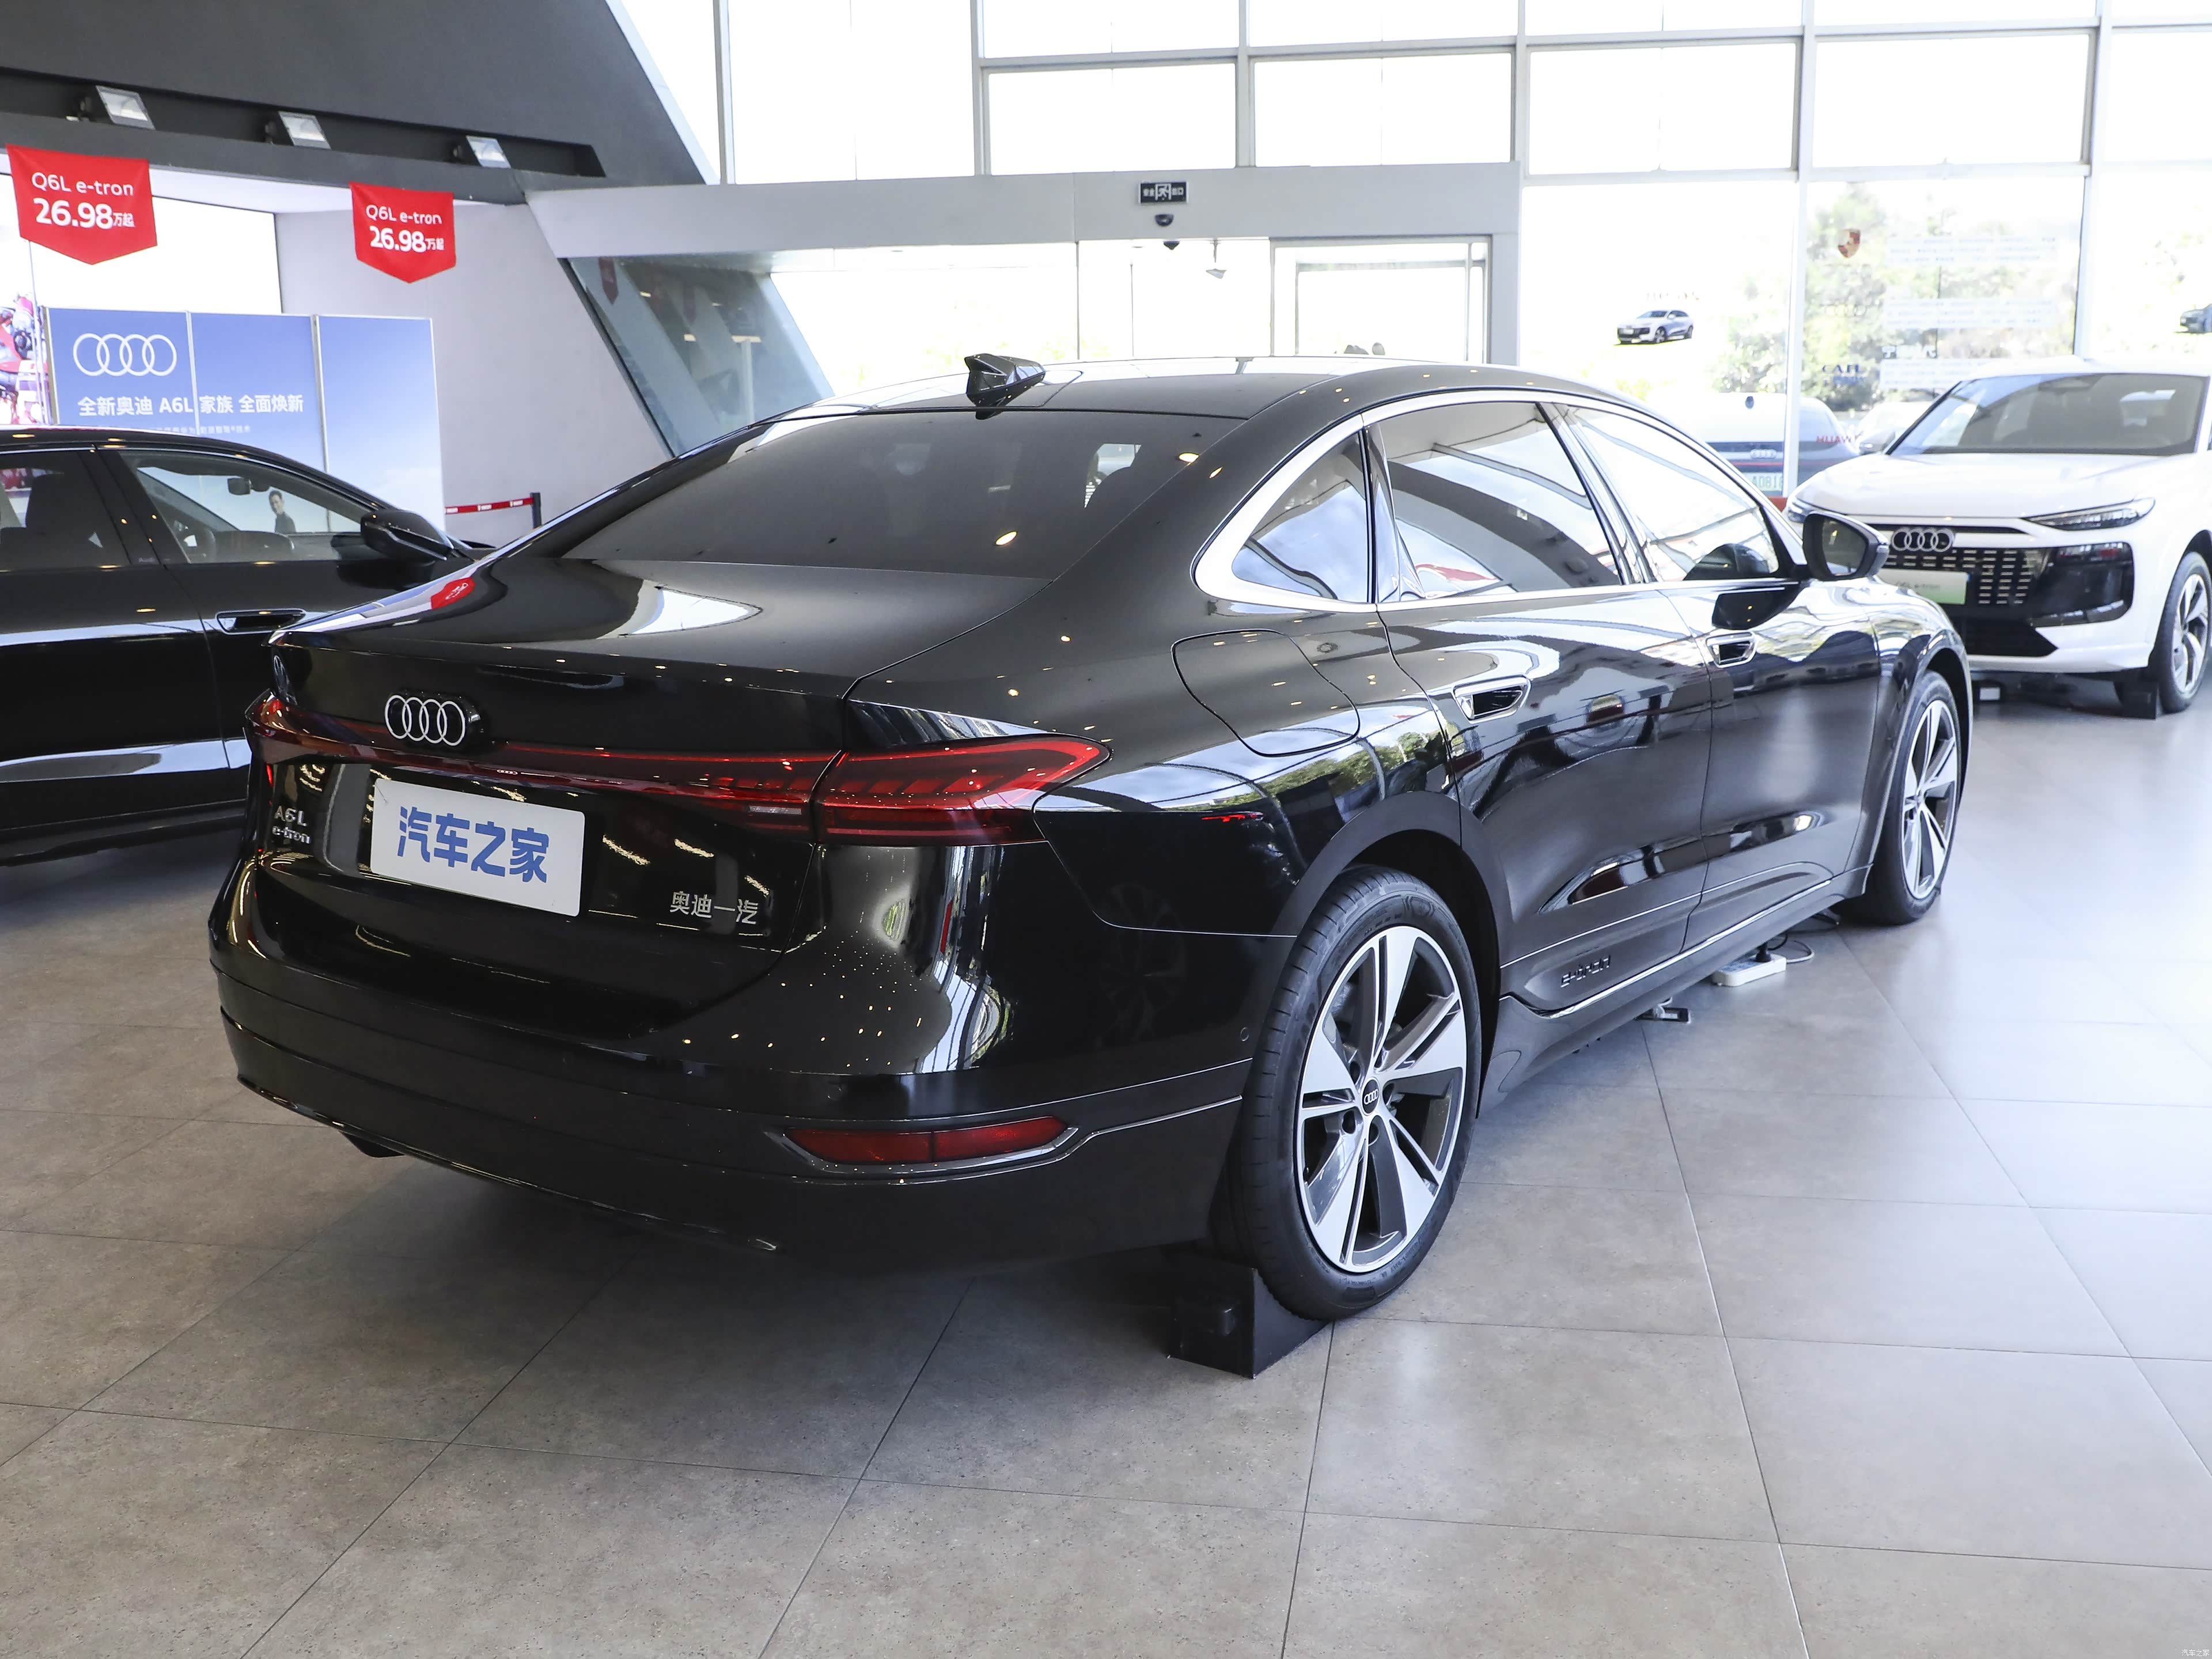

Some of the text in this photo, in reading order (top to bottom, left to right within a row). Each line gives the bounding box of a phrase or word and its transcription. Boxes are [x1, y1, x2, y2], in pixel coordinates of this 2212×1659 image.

[31, 172, 134, 196] Q6L e-tron
[366, 204, 442, 225] Q6L e-tron
[77, 394, 304, 416] 全新奥迪 A6L 家族 全面焕新
[274, 805, 308, 827] A6L
[272, 825, 312, 844] e-tron
[397, 806, 550, 883] 汽车之家
[669, 891, 759, 925] 奥迪一汽
